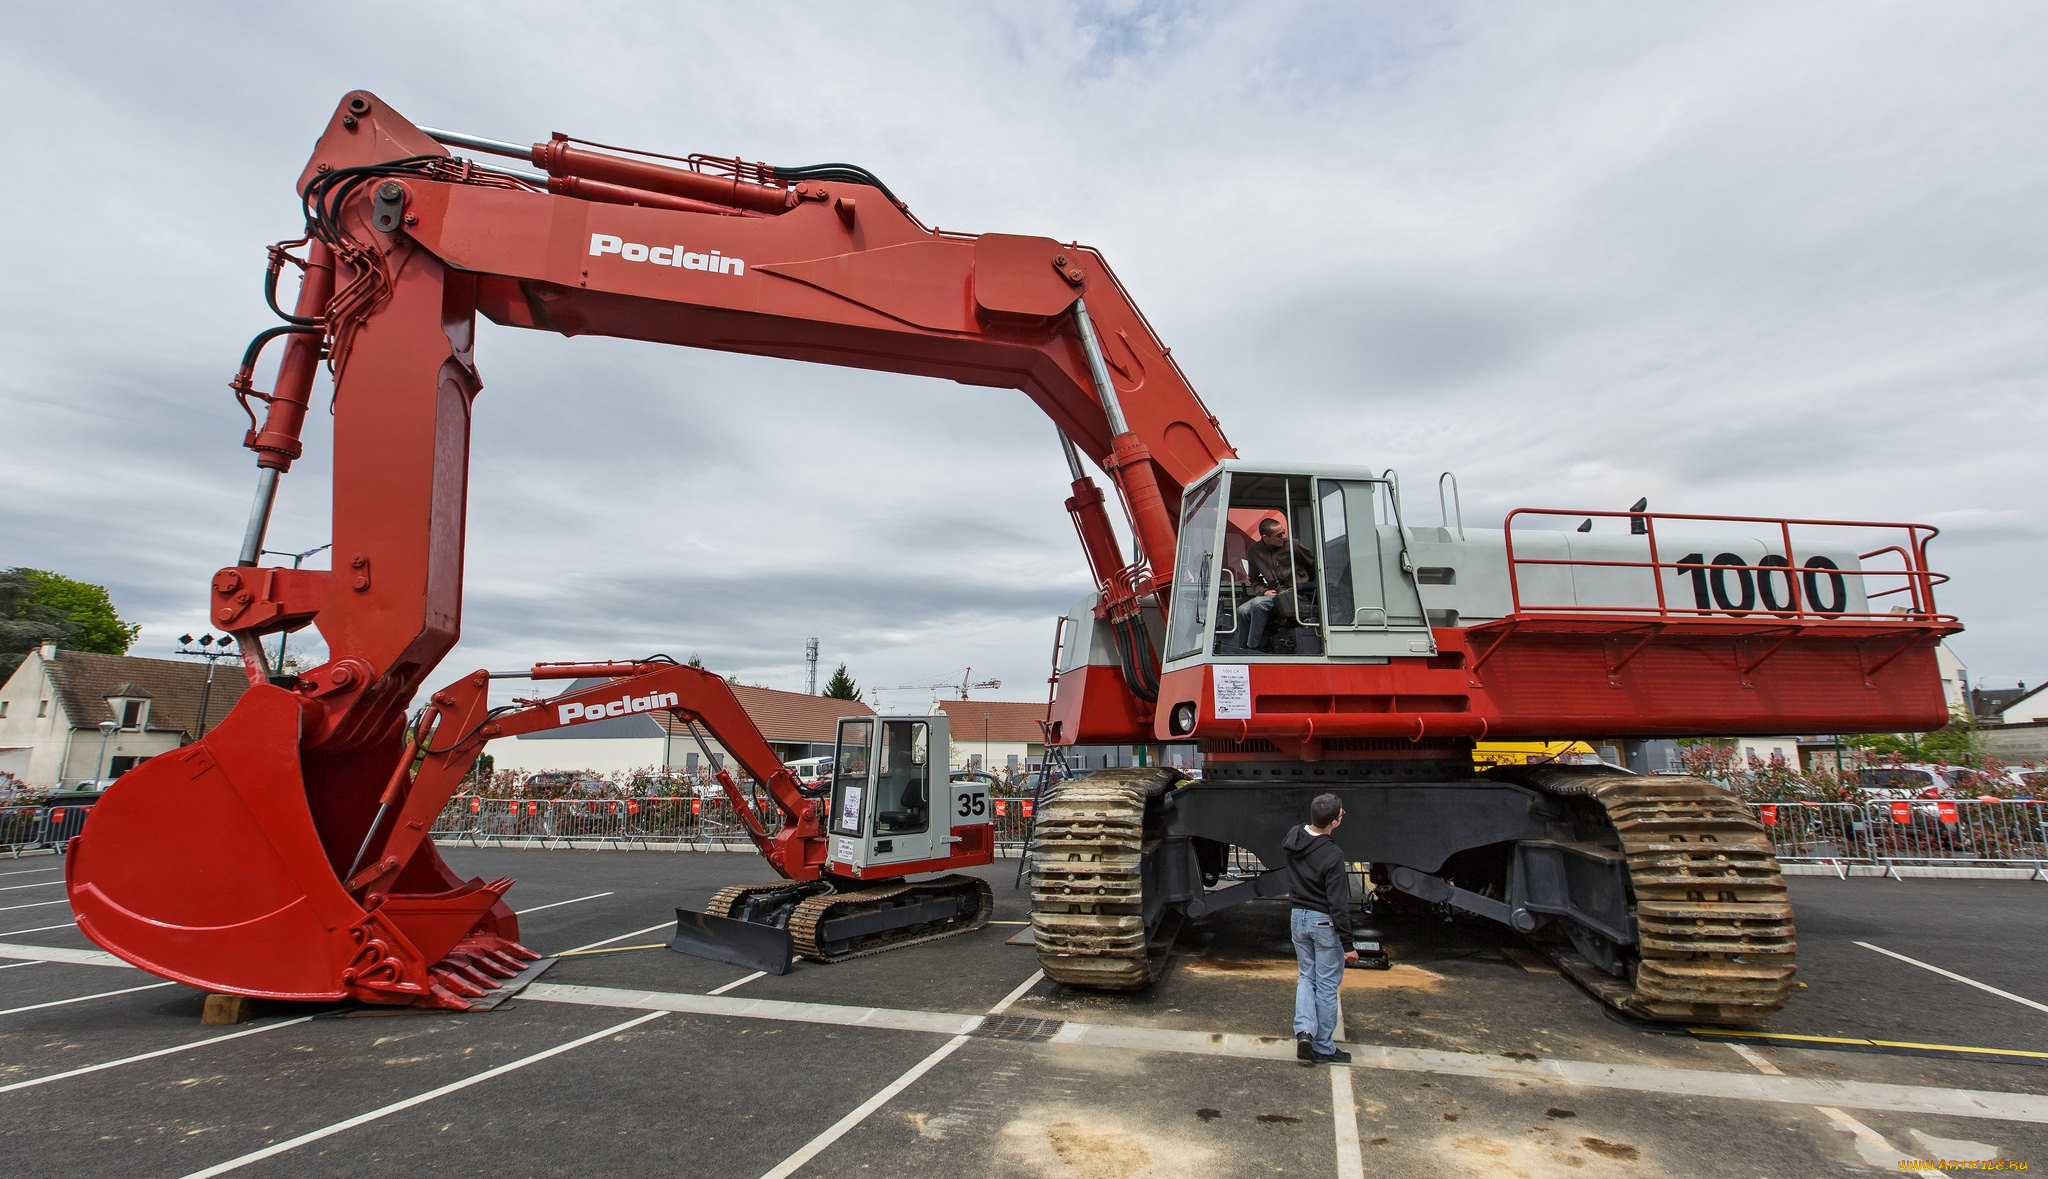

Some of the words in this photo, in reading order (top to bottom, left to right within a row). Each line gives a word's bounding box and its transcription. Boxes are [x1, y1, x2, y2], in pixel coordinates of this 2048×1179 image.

[589, 233, 745, 276] Poclain
[1676, 552, 1847, 620] 1000
[558, 691, 679, 725] Poclain
[958, 792, 985, 817] 35
